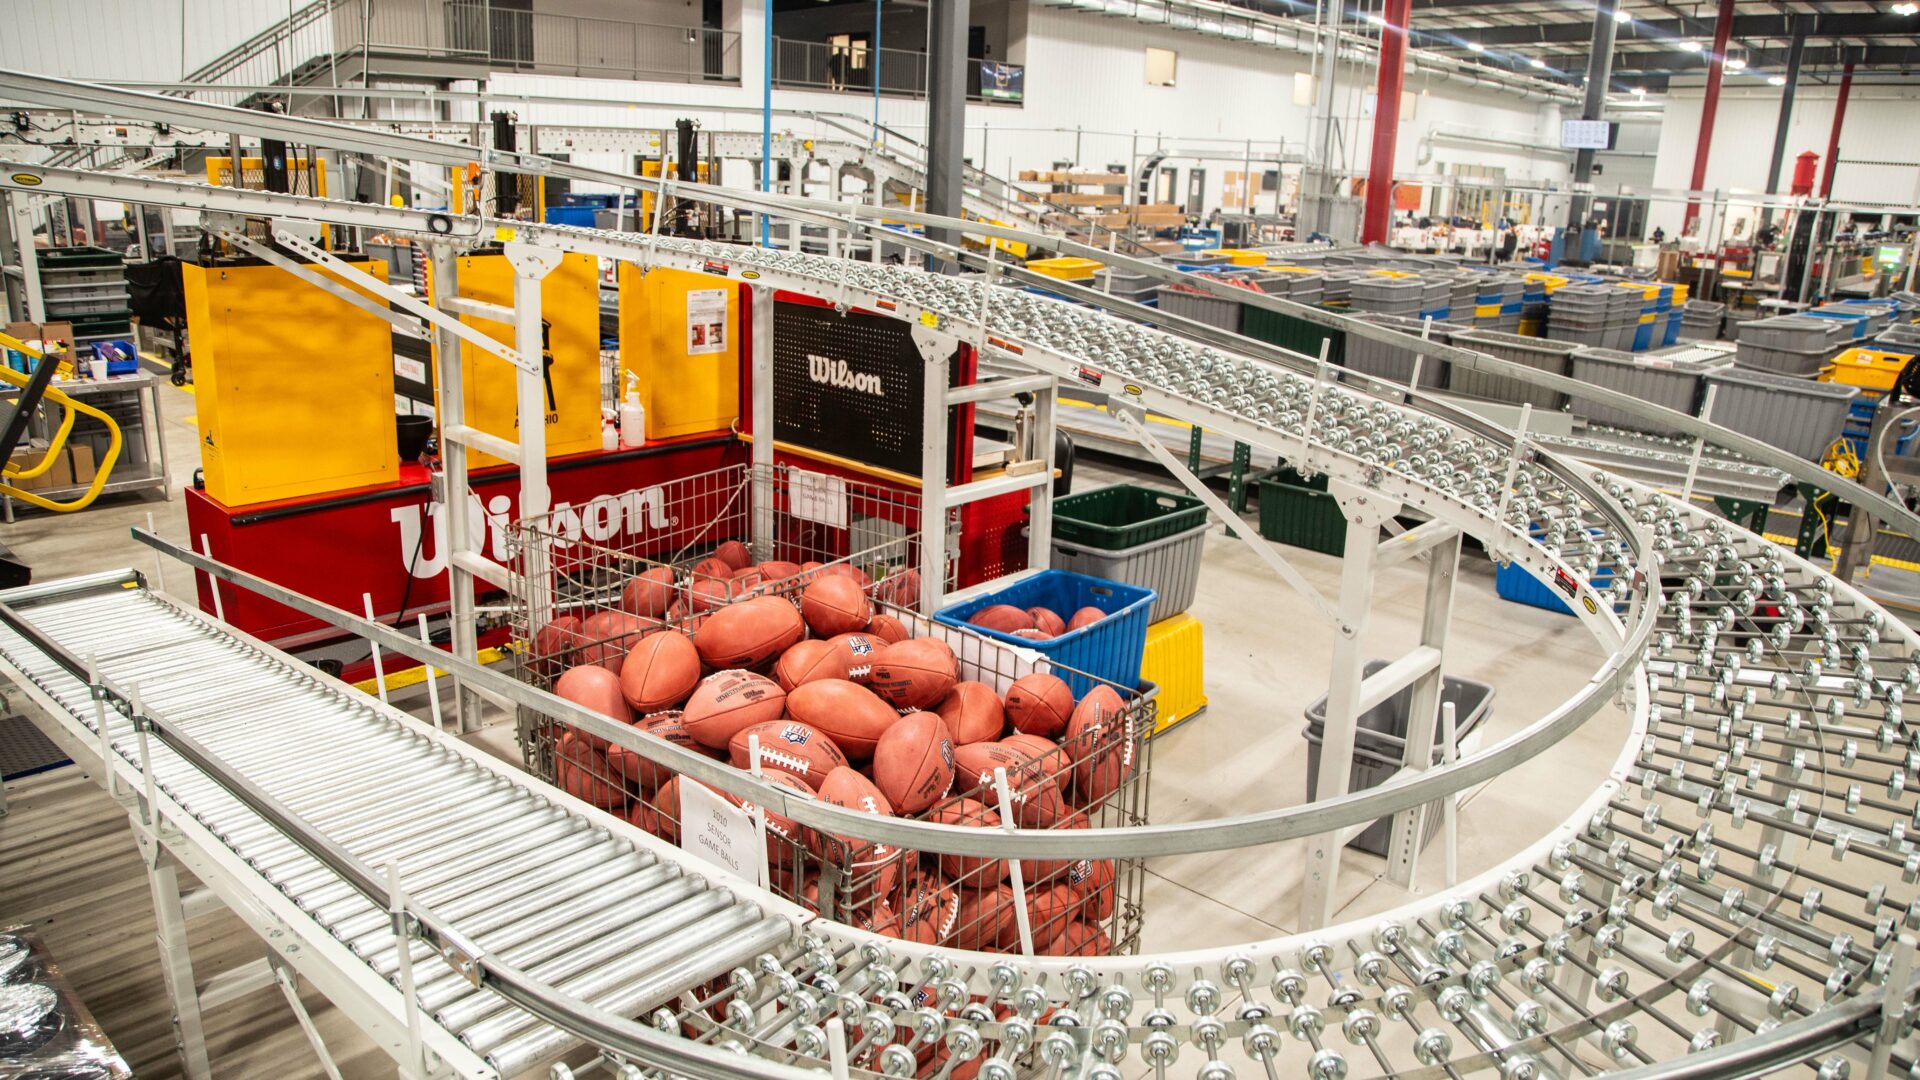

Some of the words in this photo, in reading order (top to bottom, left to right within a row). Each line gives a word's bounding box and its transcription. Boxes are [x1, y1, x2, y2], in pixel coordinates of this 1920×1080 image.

[807, 354, 881, 396] Wilson
[391, 484, 669, 579] Wison
[707, 821, 732, 848] SENSOR
[712, 809, 728, 828] 1010
[698, 834, 720, 855] GAME
[720, 848, 739, 871] BALLS
